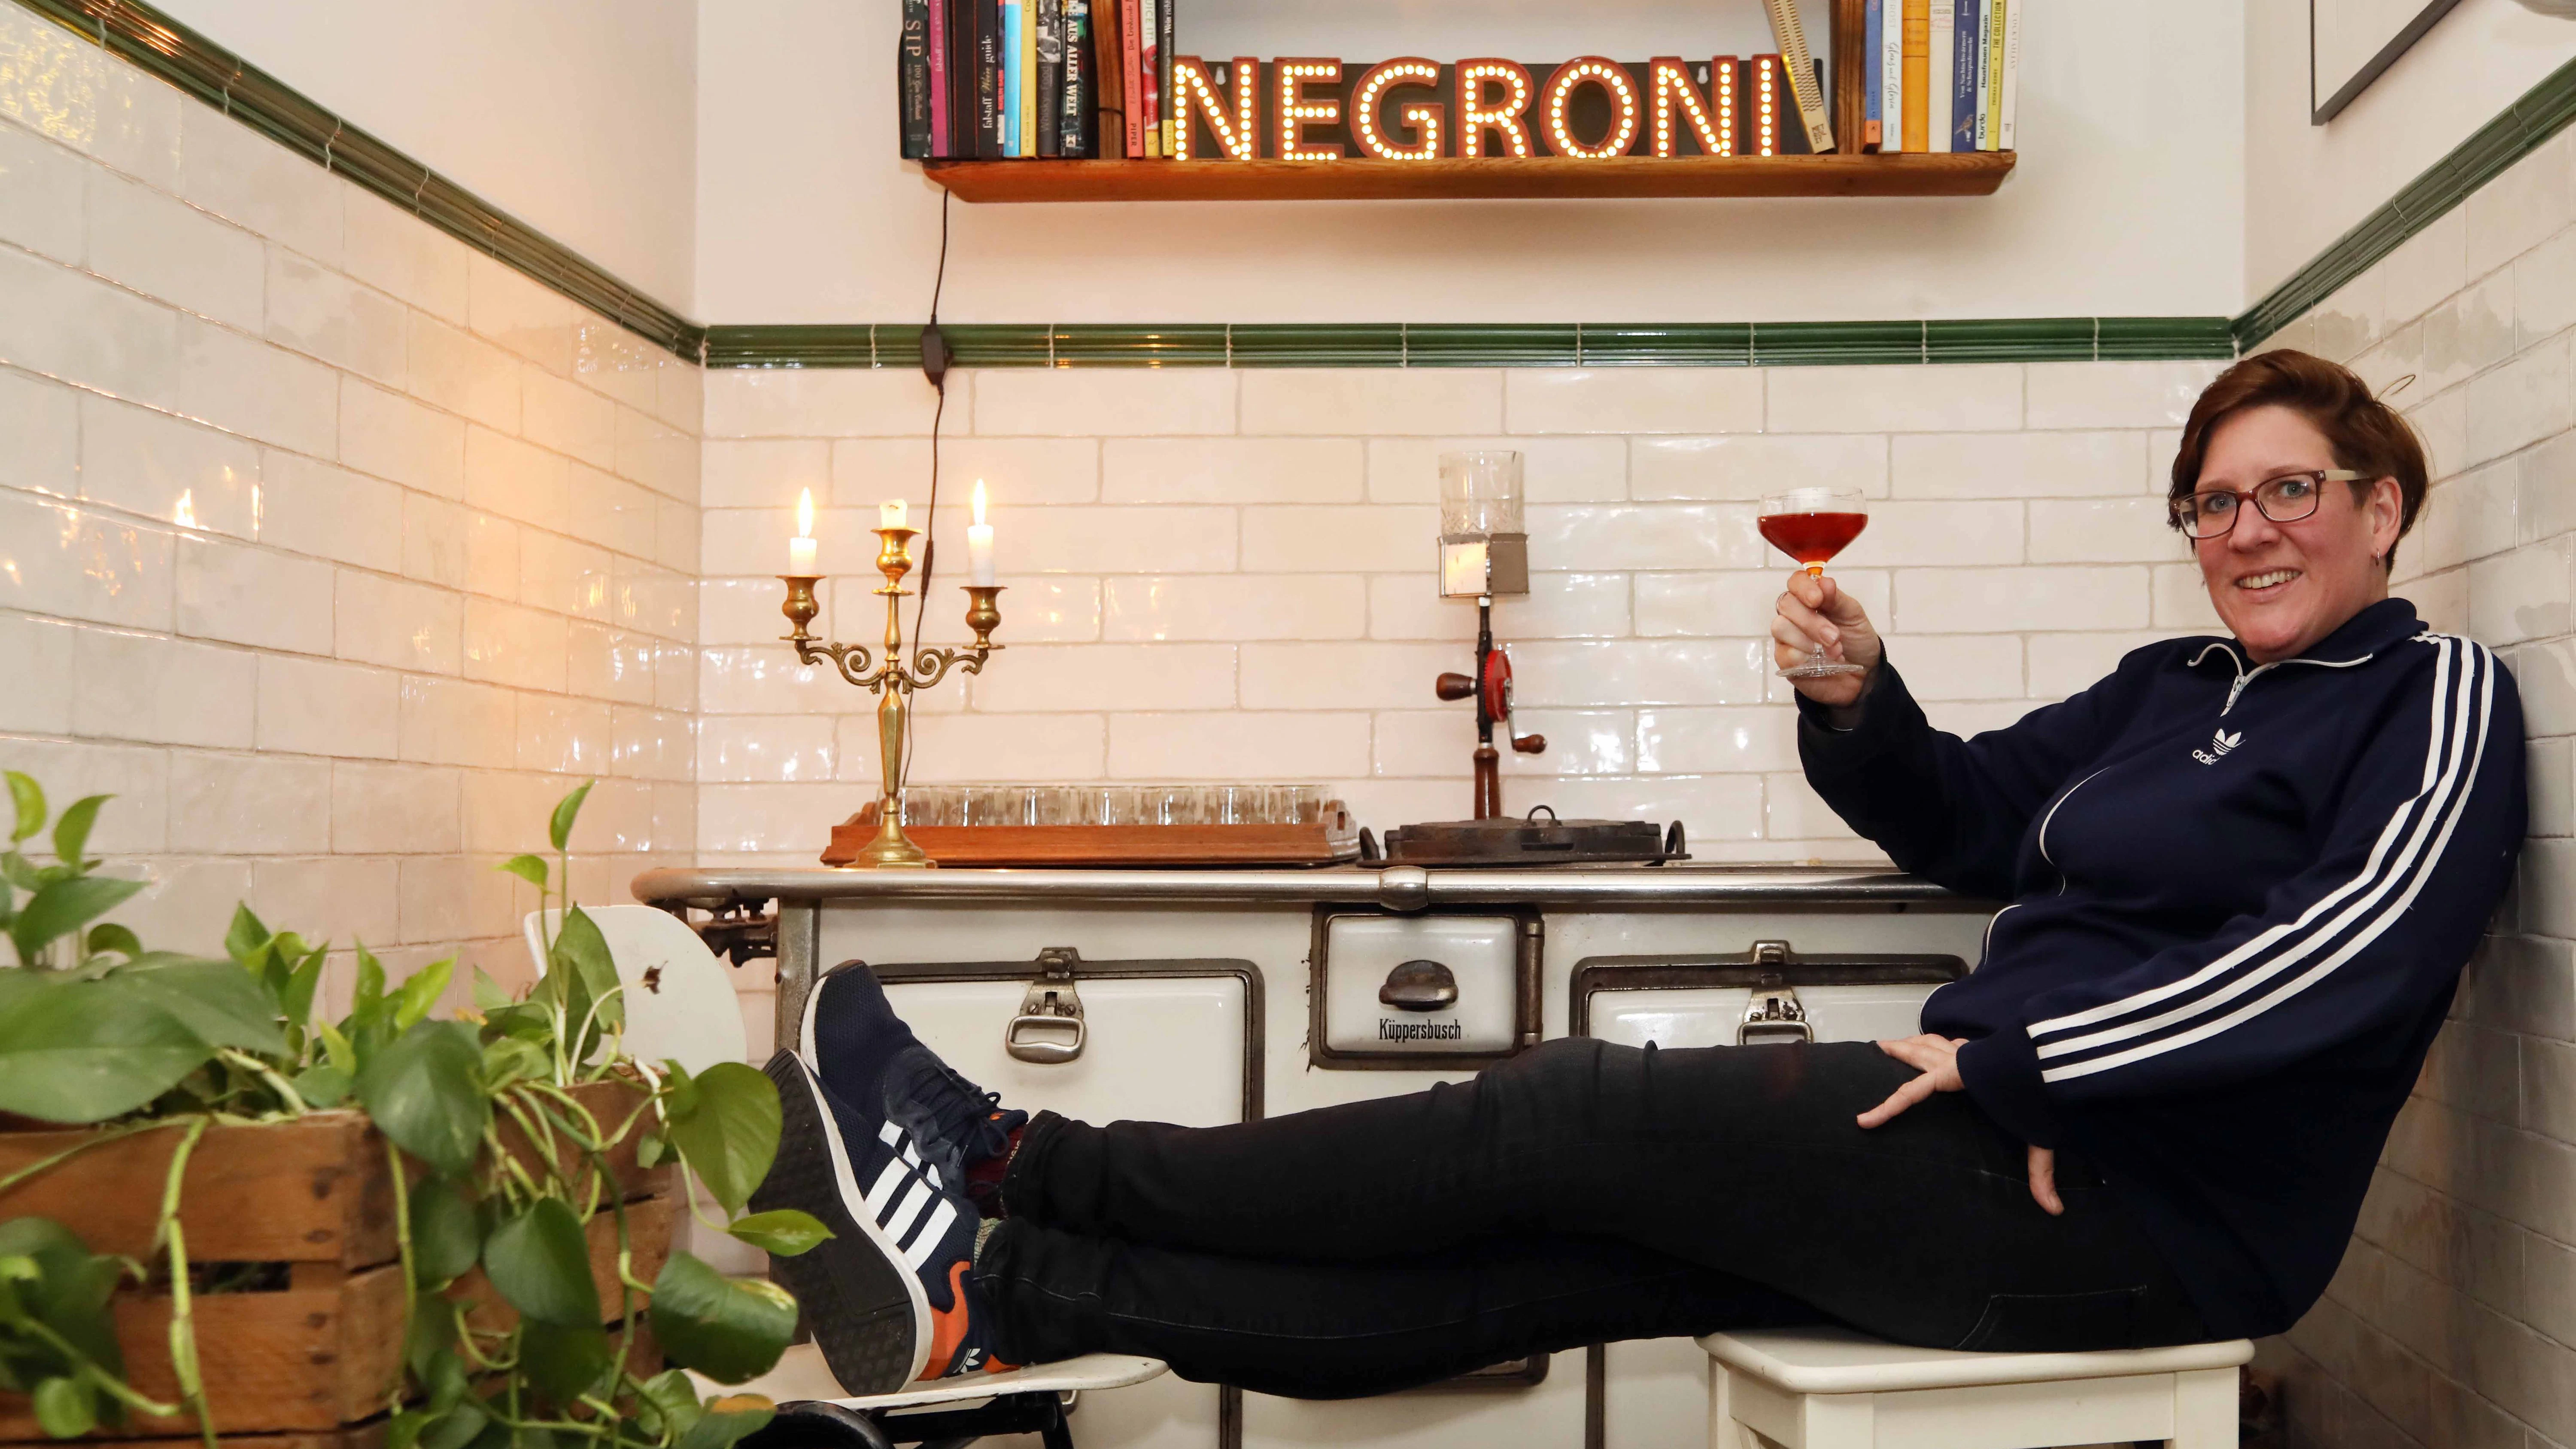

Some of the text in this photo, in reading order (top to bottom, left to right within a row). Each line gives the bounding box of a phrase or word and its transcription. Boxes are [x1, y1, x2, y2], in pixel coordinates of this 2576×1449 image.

[1126, 4, 1134, 36] trinkende
[1145, 0, 1154, 24] UICE
[1163, 17, 1172, 34] Wein
[1994, 2, 2002, 36] COLLECTION
[905, 20, 921, 57] SIP
[1067, 19, 1078, 43] AUS
[1067, 45, 1078, 82] ALLER
[982, 96, 992, 128] falstaff
[1039, 98, 1051, 132] Whisky
[1066, 84, 1077, 116] WELT
[1174, 55, 1780, 158] NEGRONI
[2192, 750, 2221, 765] adid
[1379, 1018, 1461, 1043] Küppersbusch
